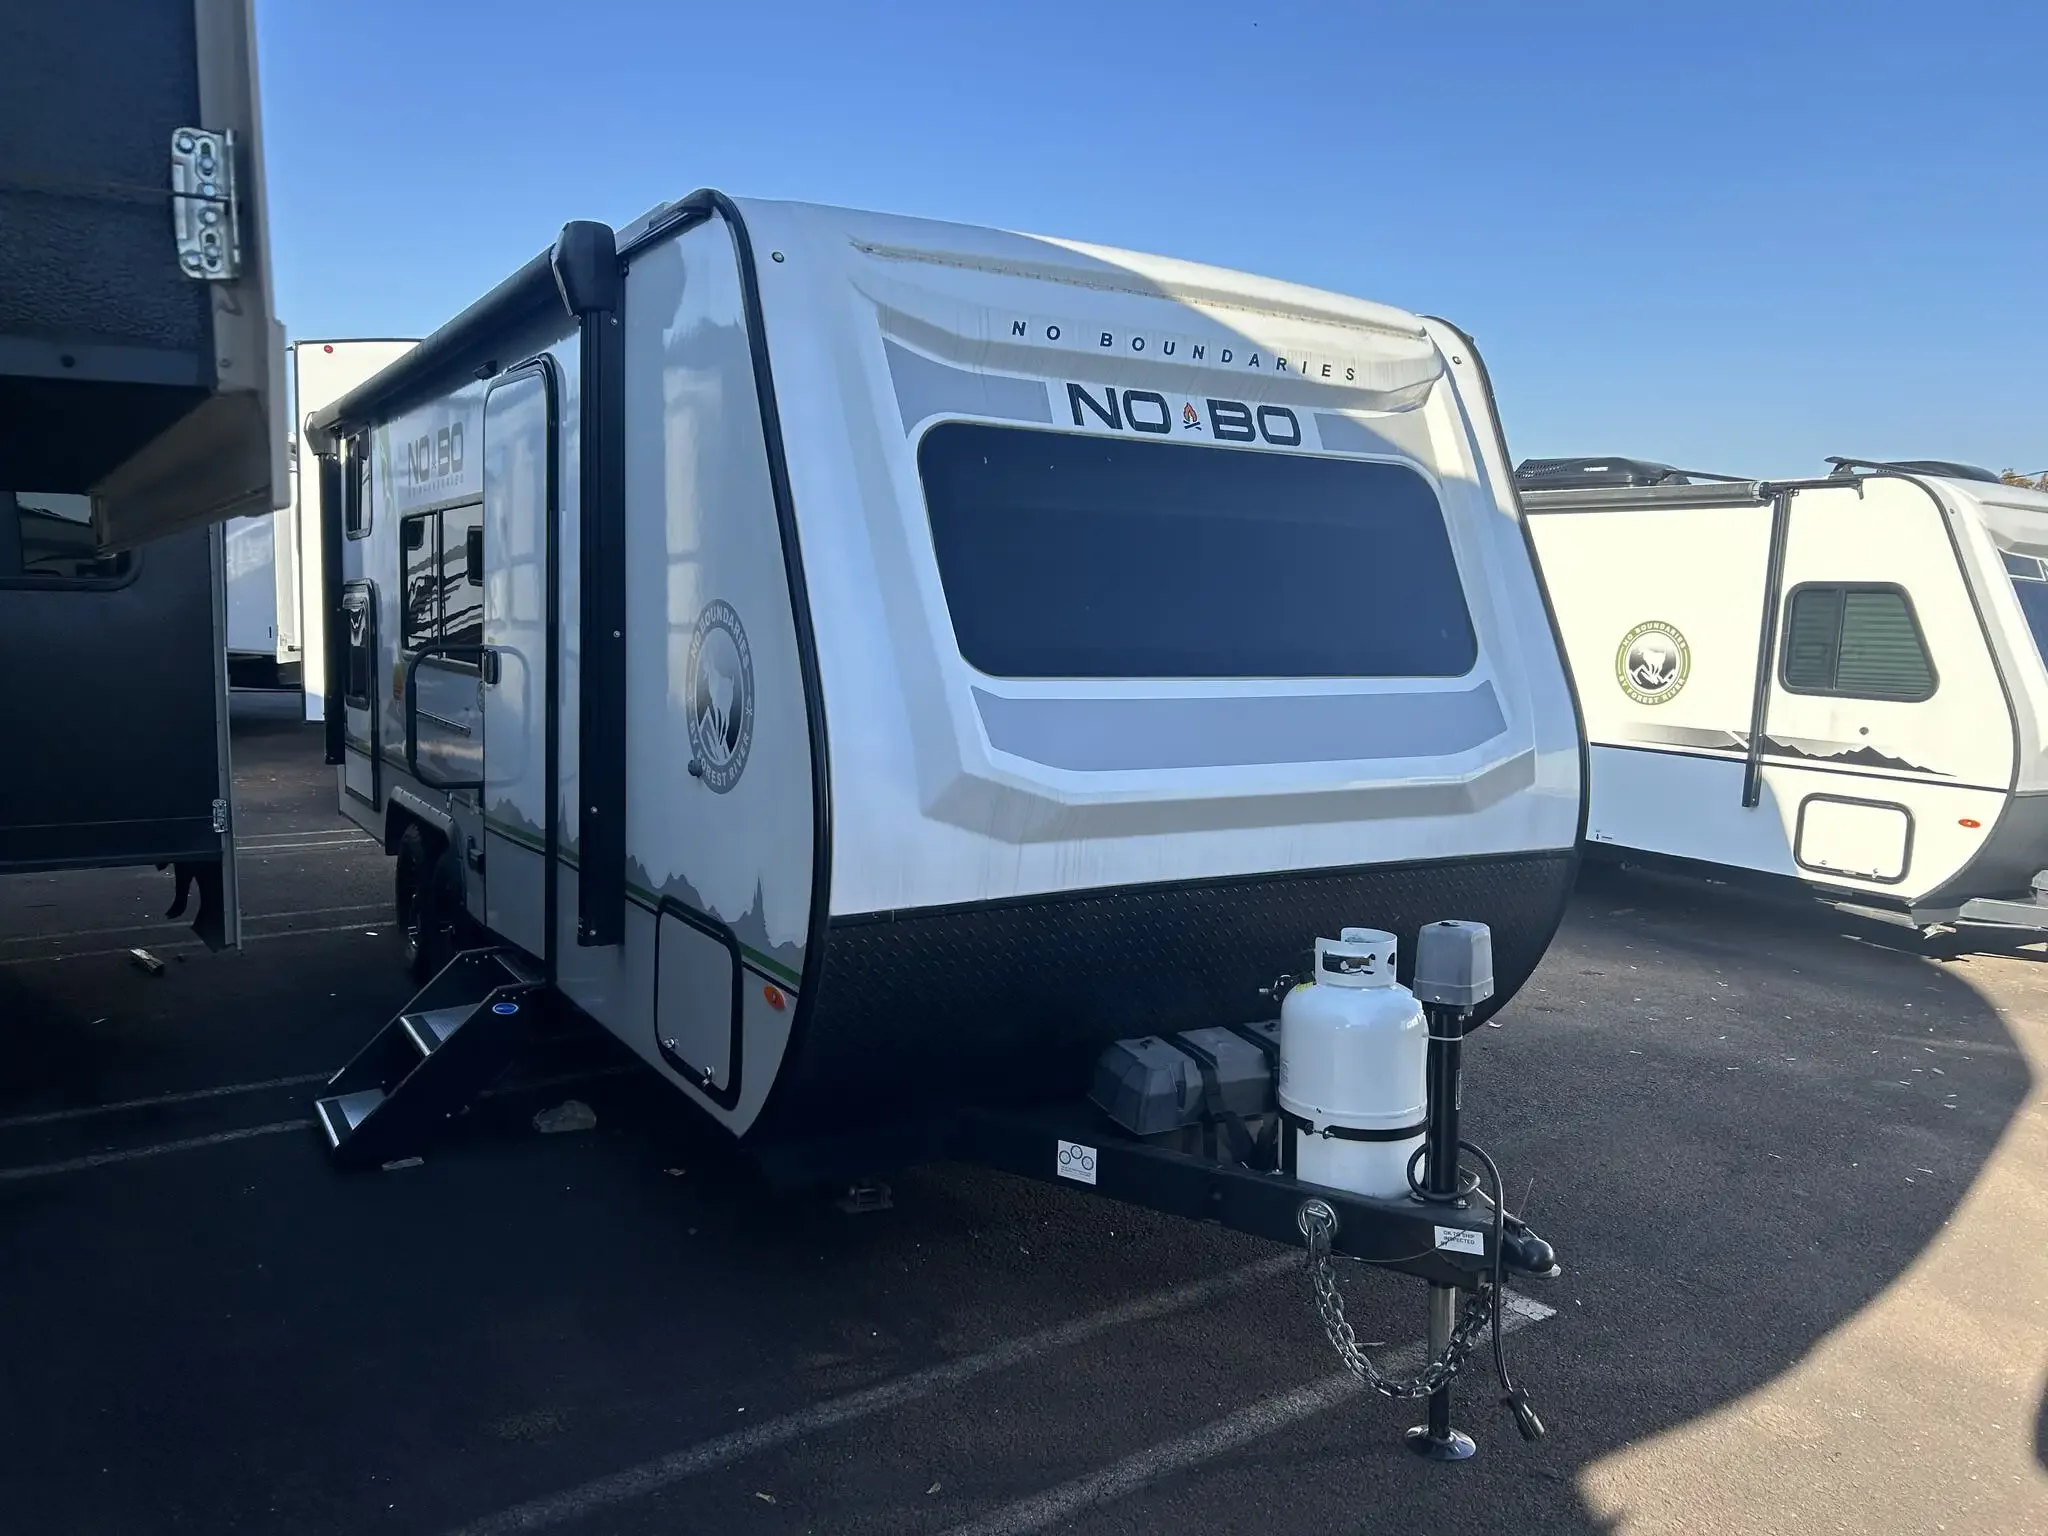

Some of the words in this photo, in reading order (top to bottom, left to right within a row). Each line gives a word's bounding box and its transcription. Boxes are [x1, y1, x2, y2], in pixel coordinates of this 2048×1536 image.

[1012, 320, 1061, 341] NO
[1100, 332, 1355, 382] BOUNDARIES
[690, 630, 701, 659] NO
[699, 604, 750, 670] BOUNDARIES
[1621, 633, 1633, 645] NO
[1635, 622, 1687, 649] BOUNDARIES
[728, 731, 750, 781] RIVER
